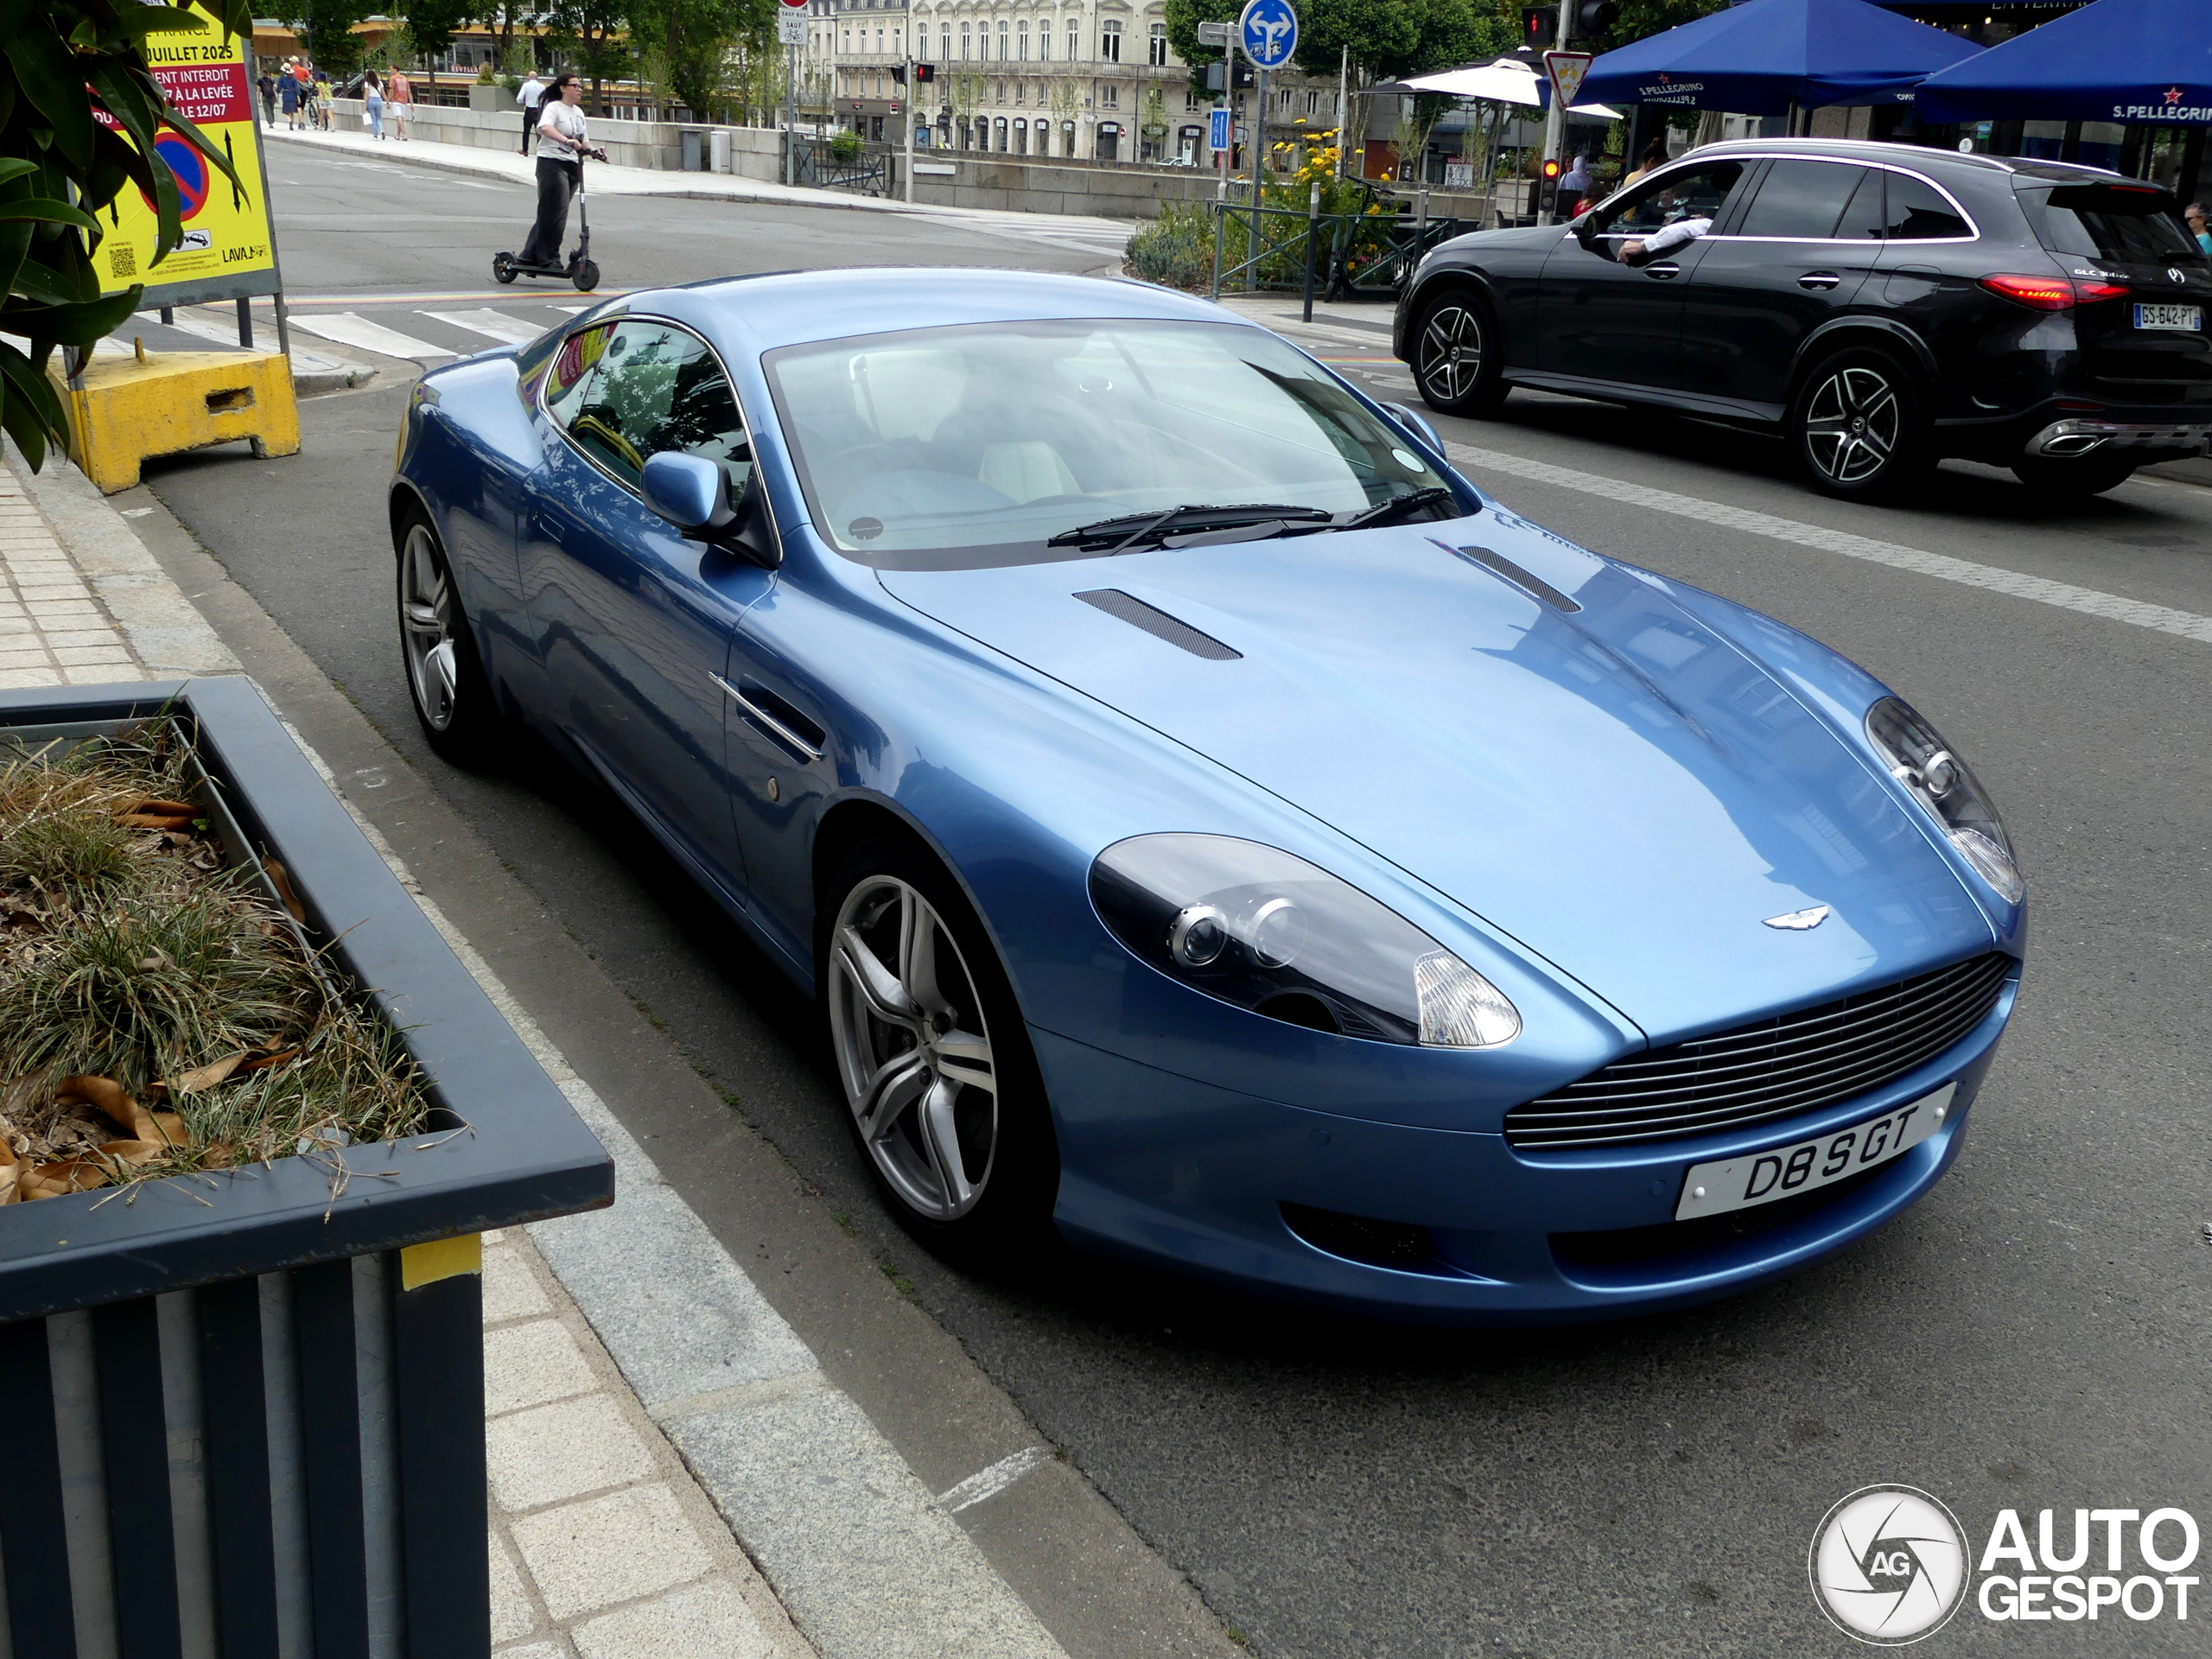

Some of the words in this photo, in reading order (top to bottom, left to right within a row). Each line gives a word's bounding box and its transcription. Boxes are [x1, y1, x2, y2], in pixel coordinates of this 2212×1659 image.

[148, 47, 198, 61] JUILLET
[201, 46, 232, 60] 2025
[180, 68, 231, 83] INTERDIT
[175, 86, 184, 101] À
[186, 88, 200, 100] LA
[201, 86, 234, 99] LEVÉE
[182, 106, 195, 118] LE
[197, 104, 226, 118] 12/07
[2143, 307, 2192, 325] GS-642-PT
